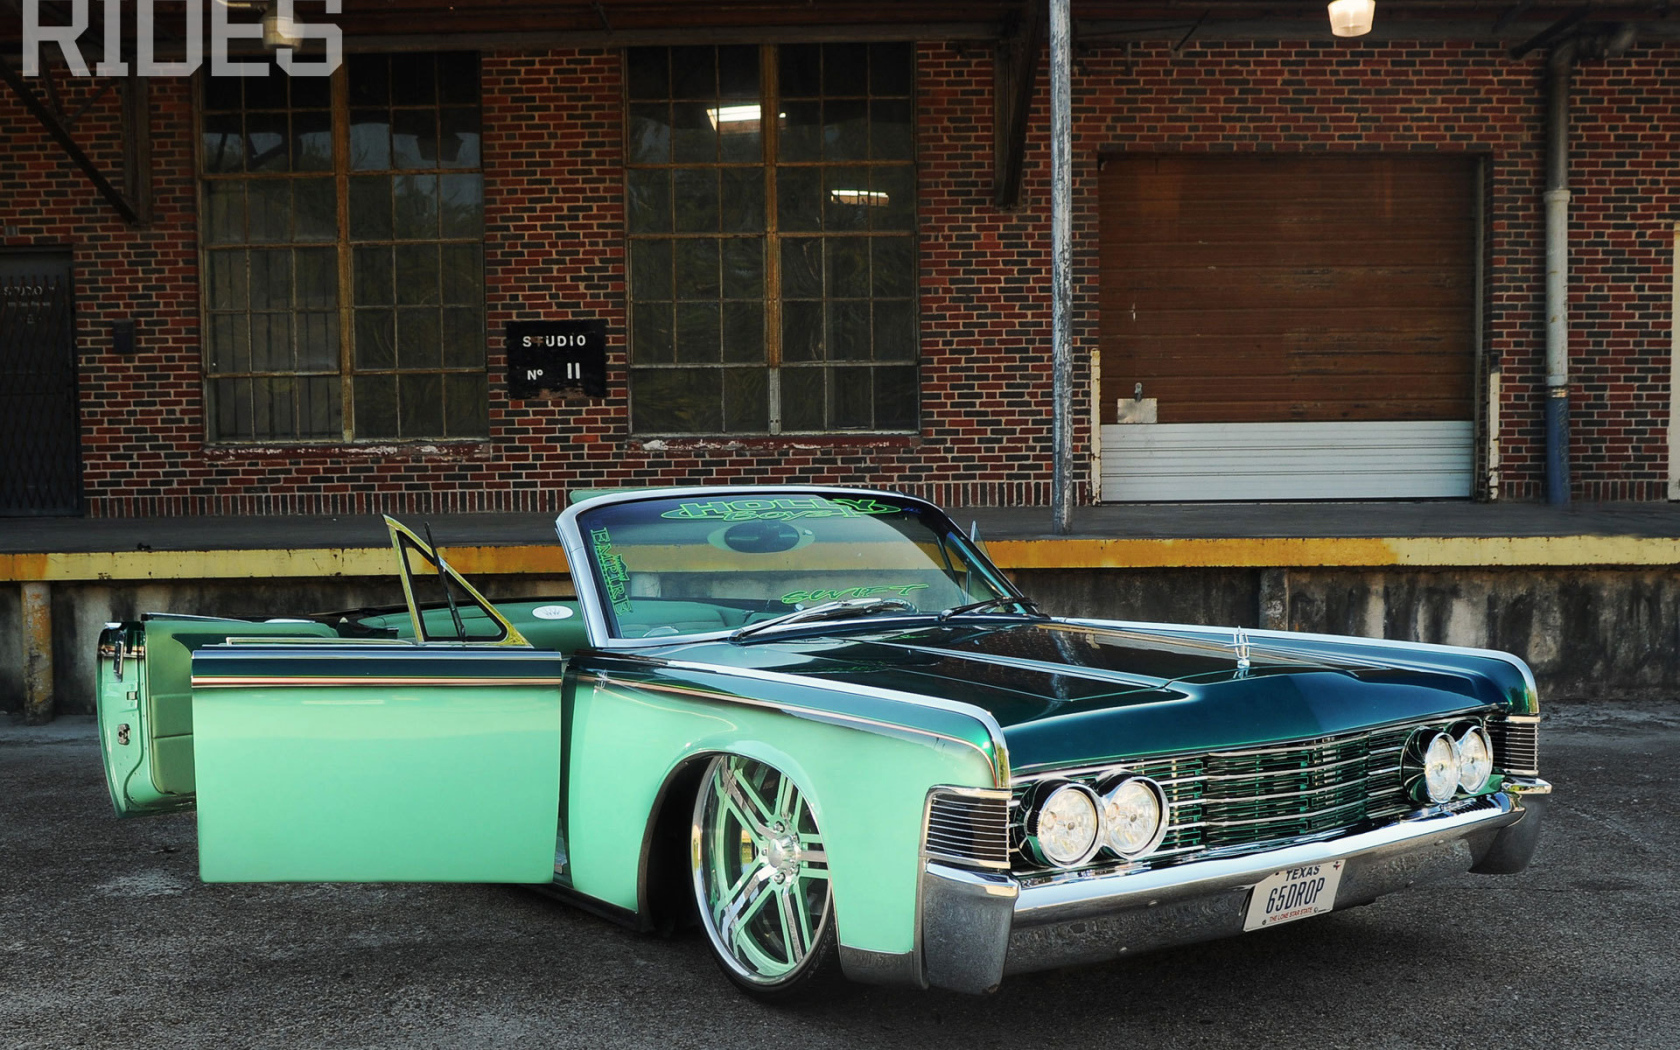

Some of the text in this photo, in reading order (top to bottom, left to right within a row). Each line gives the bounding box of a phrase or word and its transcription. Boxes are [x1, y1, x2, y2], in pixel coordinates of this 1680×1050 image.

[590, 527, 633, 615] EMPIRE
[1286, 865, 1321, 881] TEXAS
[1266, 877, 1326, 914] 65DROP
